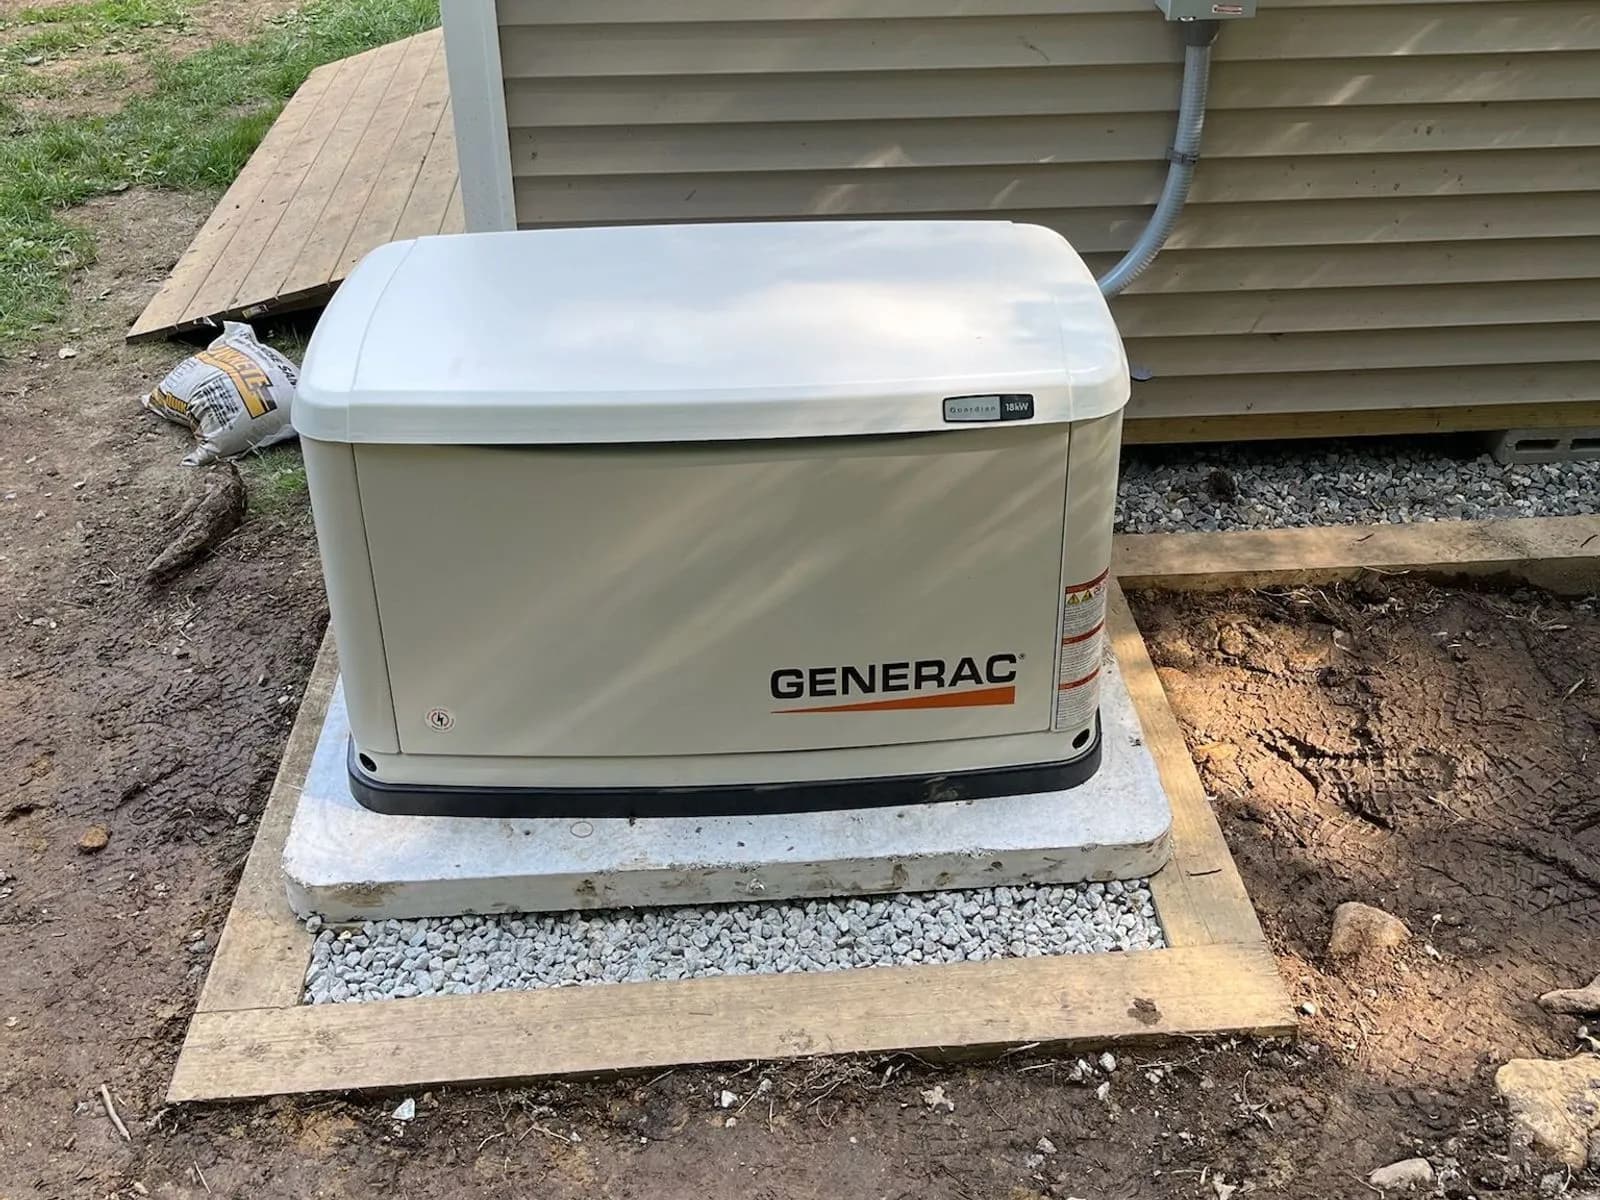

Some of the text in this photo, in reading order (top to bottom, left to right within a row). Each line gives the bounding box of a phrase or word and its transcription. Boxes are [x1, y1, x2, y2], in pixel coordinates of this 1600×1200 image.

[949, 402, 1029, 413] Guardian 18kW
[771, 653, 1017, 699] GENERAC
